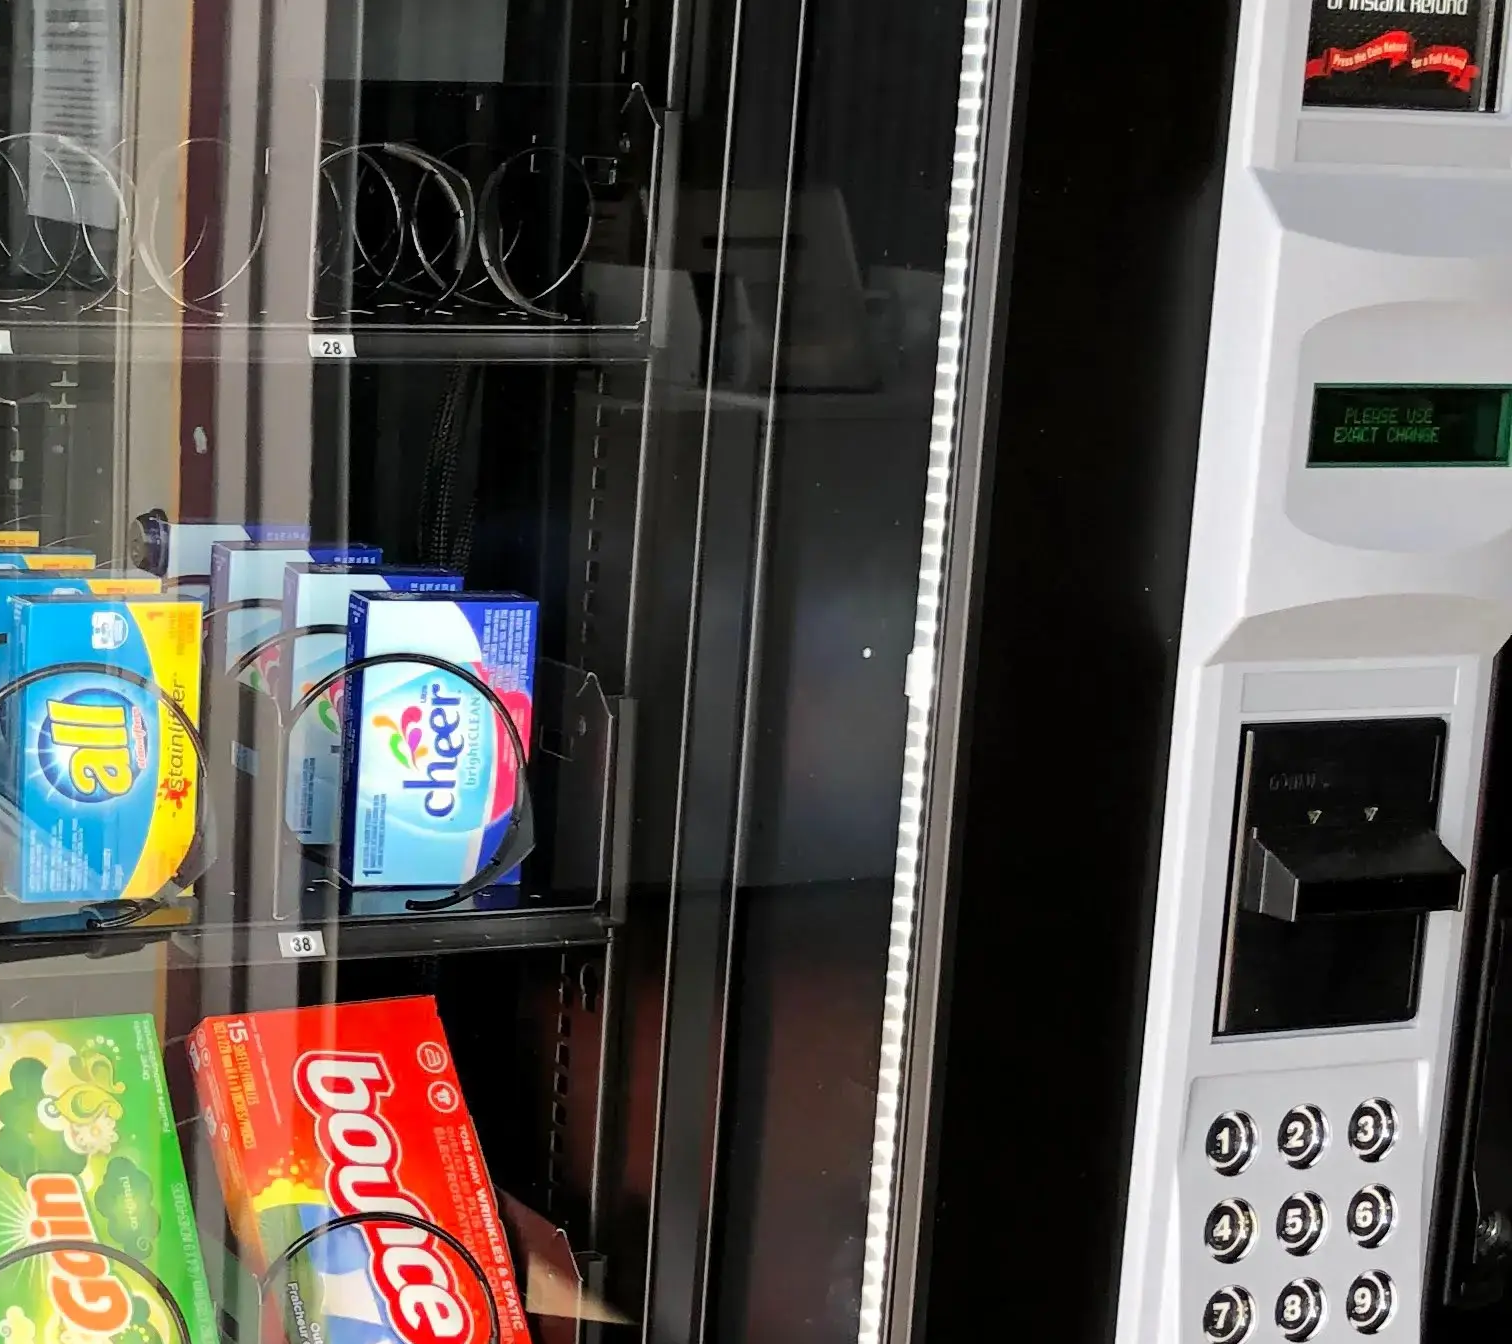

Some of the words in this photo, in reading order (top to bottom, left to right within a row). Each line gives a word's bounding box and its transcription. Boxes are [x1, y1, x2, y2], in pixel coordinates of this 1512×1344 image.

[1367, 46, 1383, 58] Coin
[1429, 53, 1442, 62] Full
[322, 340, 342, 356] 28
[1344, 407, 1398, 425] PLEASE
[1407, 407, 1434, 424] USE
[1333, 426, 1379, 444] EXACT
[1386, 426, 1440, 444] CHANGE
[47, 700, 134, 796] all
[403, 684, 465, 818] cheer
[464, 692, 482, 787] brightCLEAN
[293, 937, 311, 951] 38
[227, 1020, 249, 1043] 15
[458, 1124, 473, 1151] TOSS
[1217, 1127, 1230, 1154] 1
[1286, 1121, 1305, 1148] 2
[1357, 1115, 1375, 1142] 3
[467, 1150, 481, 1186] AWAY
[120, 1175, 140, 1230] original
[1355, 1201, 1373, 1228] 6
[475, 1187, 505, 1264] WRINKLES
[1212, 1214, 1232, 1241] 4
[1285, 1208, 1302, 1235] 5
[27, 1173, 131, 1333] Gain
[498, 1266, 508, 1277] &
[501, 1279, 524, 1331] STATIC
[1283, 1295, 1301, 1321] 8
[1354, 1287, 1372, 1314] 9
[1212, 1301, 1231, 1329] 7
